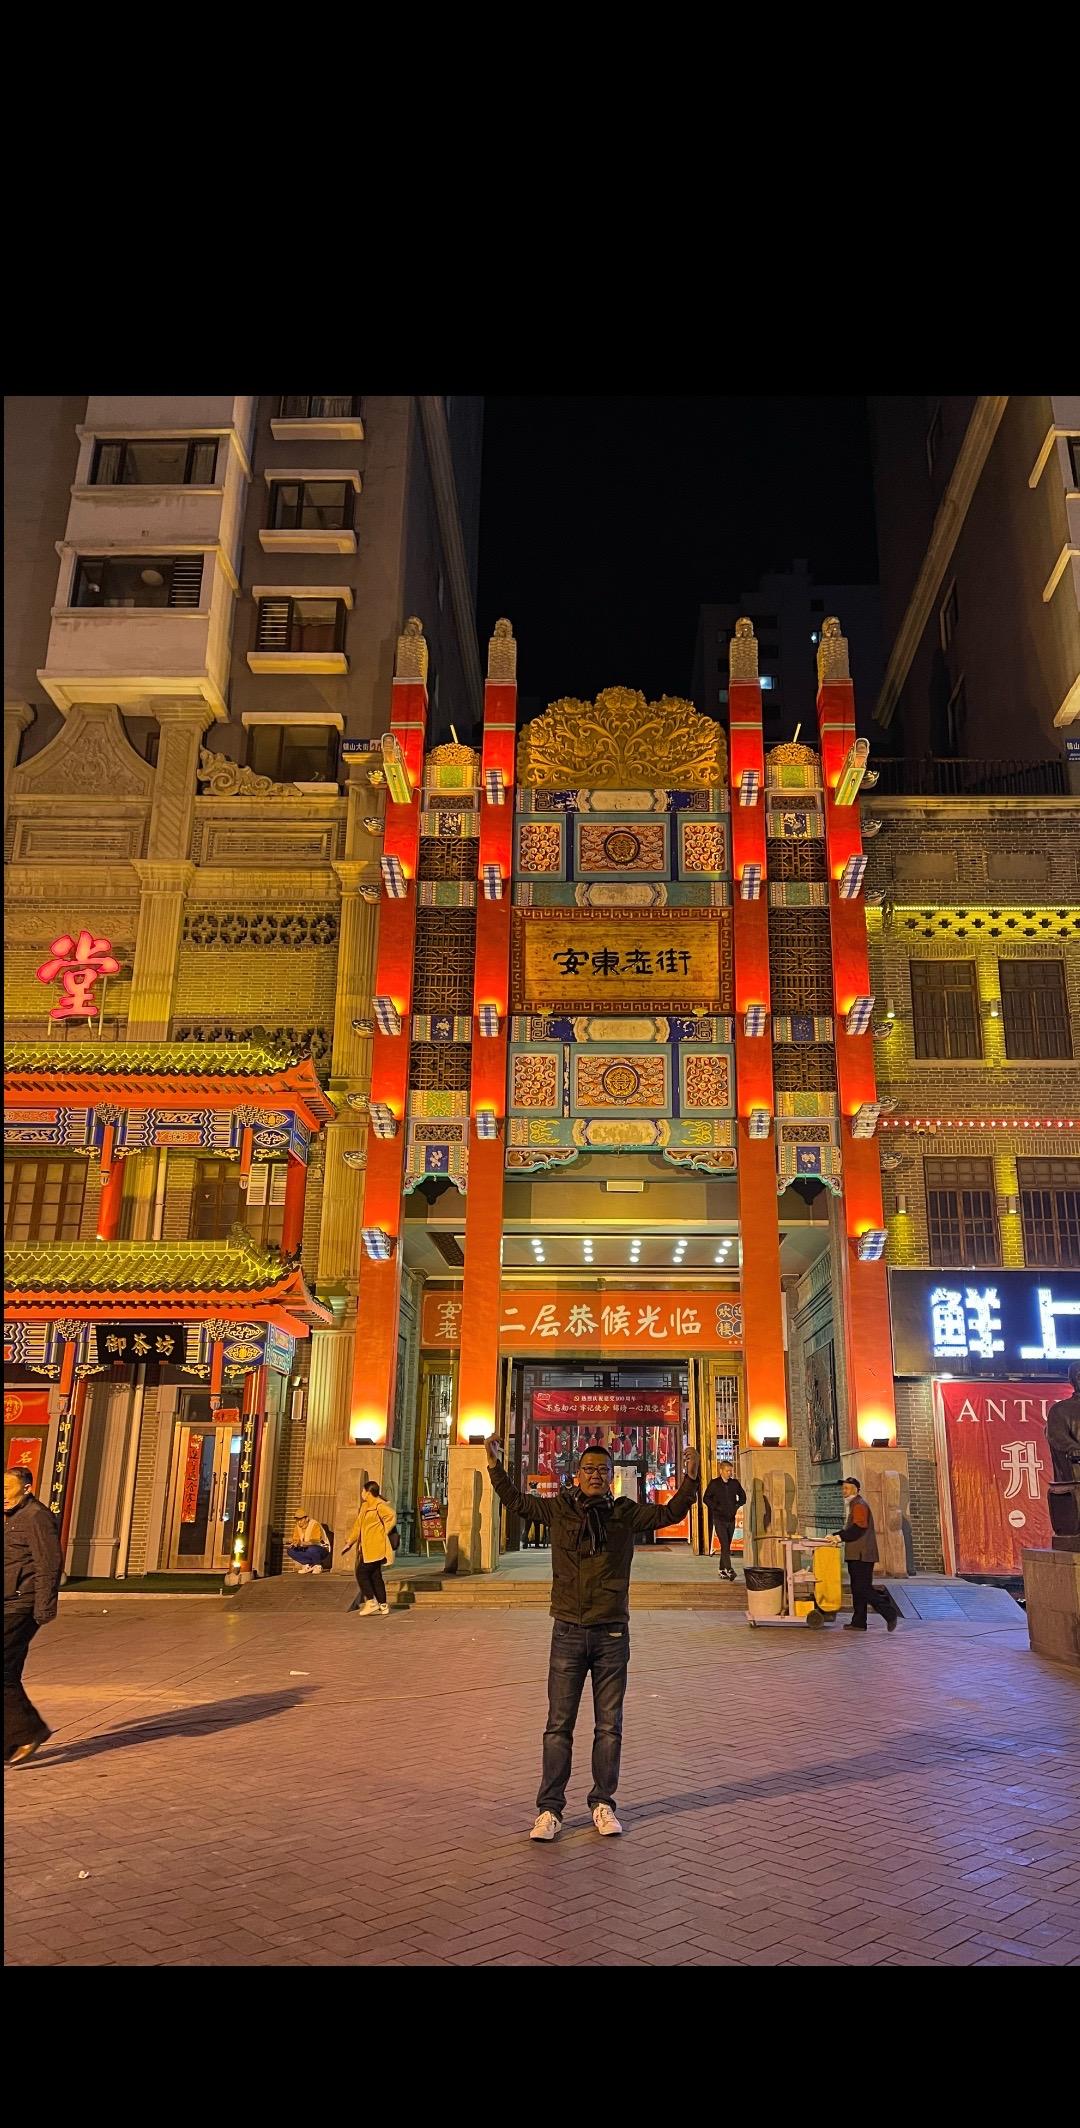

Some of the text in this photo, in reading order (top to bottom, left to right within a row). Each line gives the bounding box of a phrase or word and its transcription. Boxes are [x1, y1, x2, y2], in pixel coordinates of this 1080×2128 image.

[36, 930, 120, 1019] 堂
[104, 1332, 175, 1356] 御茶坊
[500, 1304, 701, 1338] 二层恭候光临
[1001, 1440, 1043, 1499] 升
